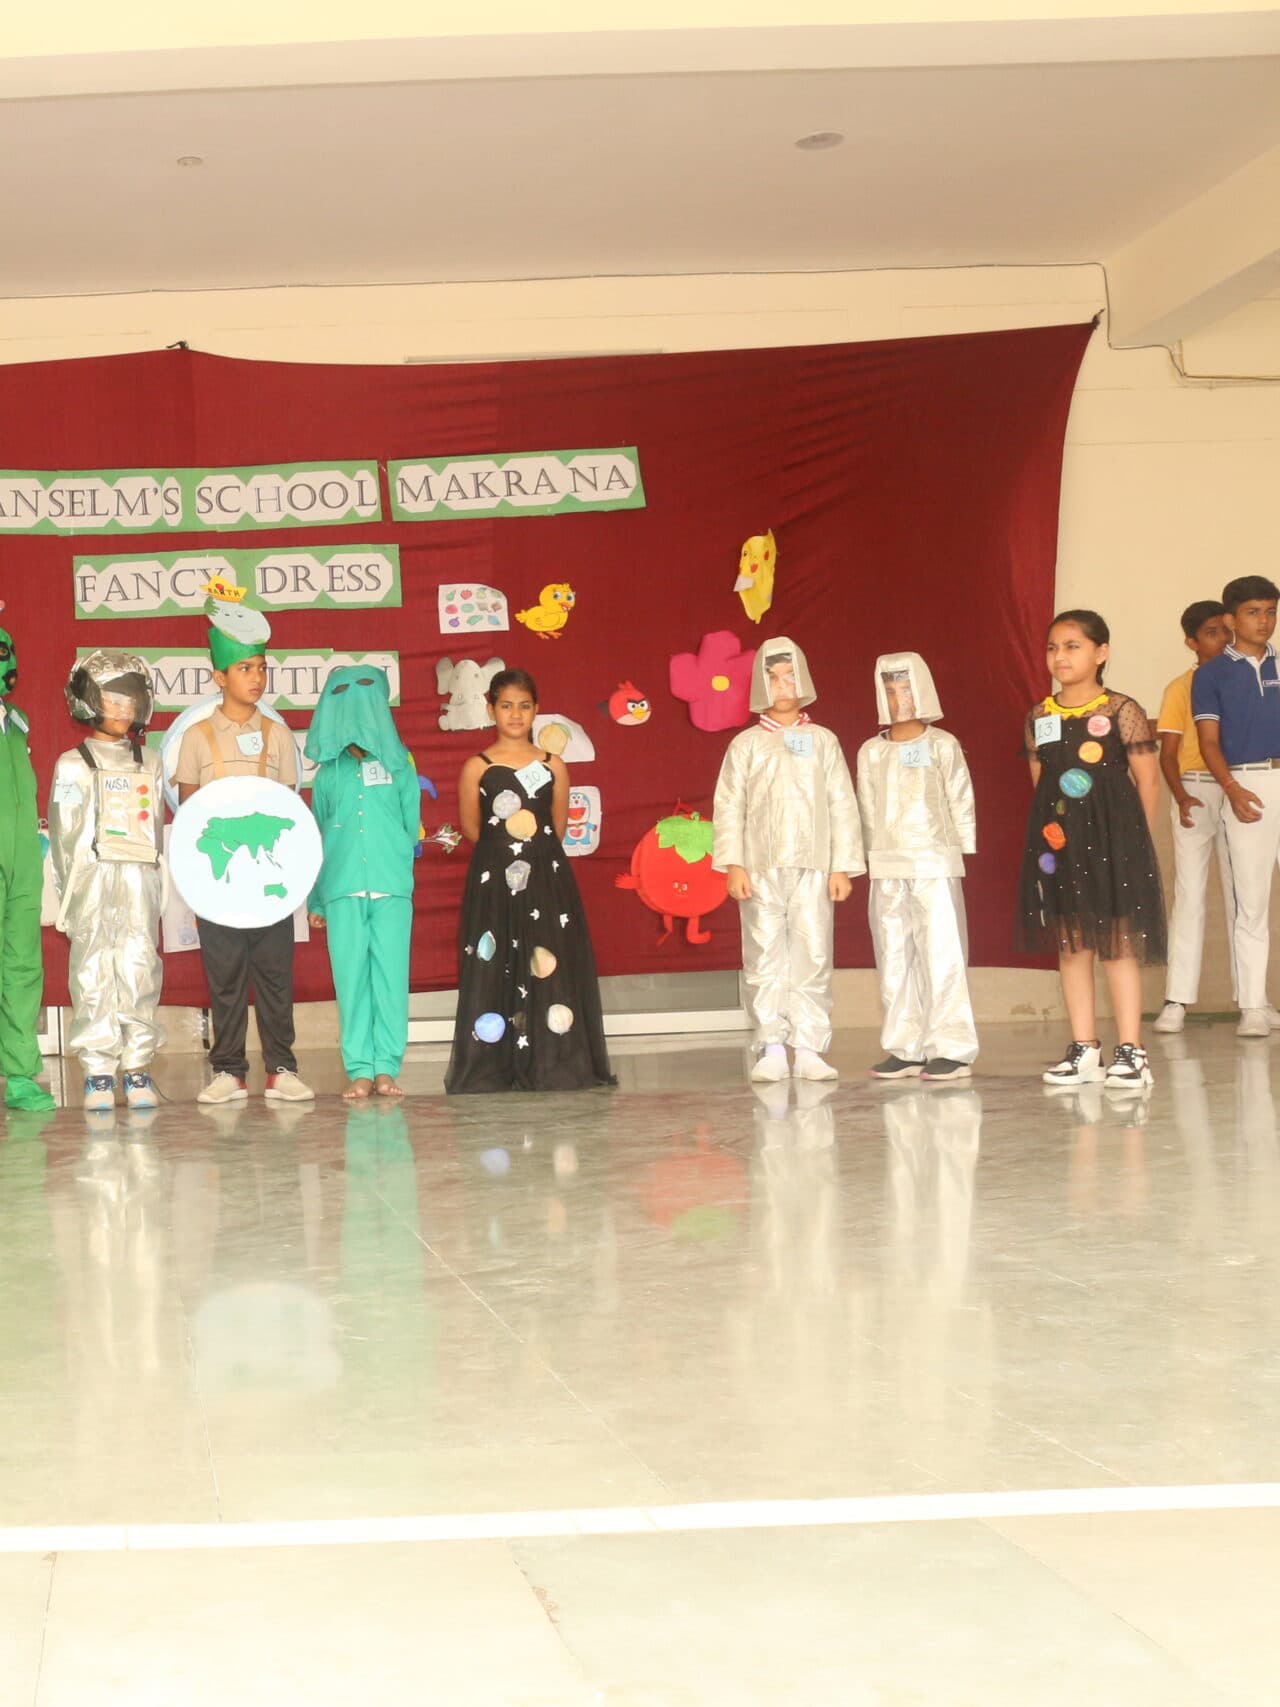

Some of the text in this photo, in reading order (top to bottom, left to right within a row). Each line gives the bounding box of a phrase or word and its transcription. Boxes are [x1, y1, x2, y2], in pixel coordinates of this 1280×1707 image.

[196, 479, 378, 515] SCHOOL
[398, 464, 633, 505] MAKRANA
[255, 563, 382, 595] DRESS
[250, 736, 261, 751] 8
[905, 750, 921, 765] 12
[370, 766, 378, 781] 9
[105, 778, 130, 791] NASA
